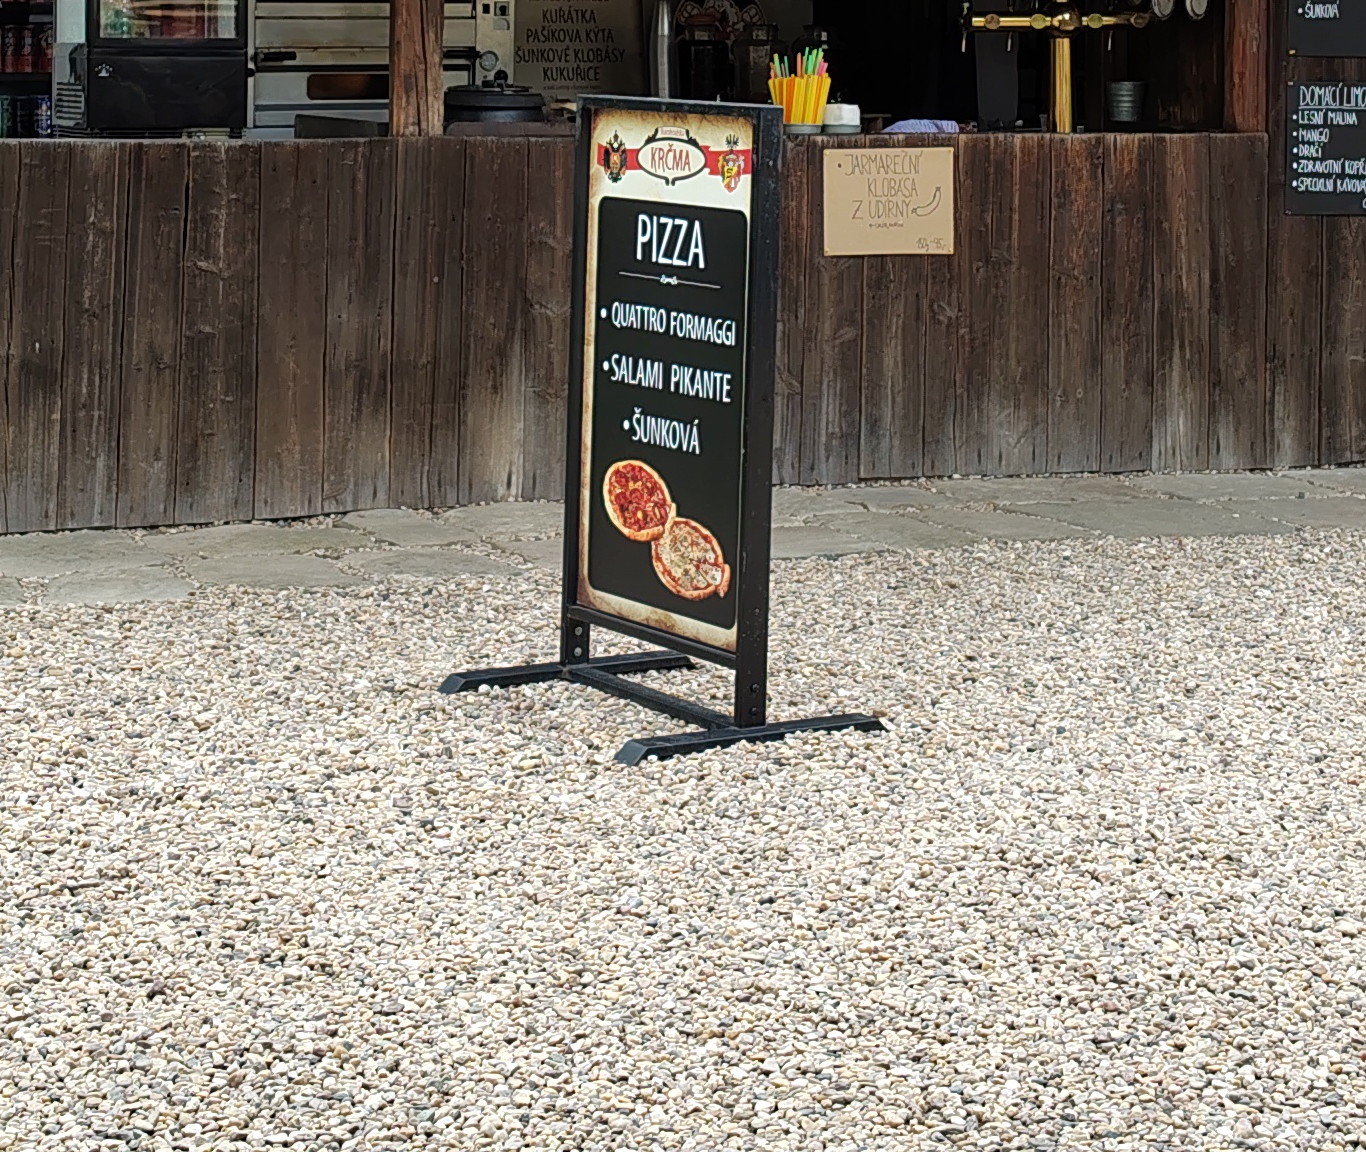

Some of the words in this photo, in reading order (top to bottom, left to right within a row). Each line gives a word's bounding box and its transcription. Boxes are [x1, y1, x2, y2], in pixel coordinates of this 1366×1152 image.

[541, 6, 597, 25] KUŘÁTKA
[1304, 0, 1340, 18] ŠUNKOVÁ
[526, 25, 582, 44] PAŠÍKOVA
[585, 25, 614, 44] KÝTA
[515, 46, 571, 65] ŠUNKOVÉ
[574, 46, 626, 65] KLOBÁSY
[542, 64, 600, 82] KUKUŘICE
[1299, 82, 1343, 106] DOMÁCÍ
[1298, 109, 1326, 125] LESNÍ
[1327, 111, 1358, 125] MALINA
[1298, 128, 1330, 142] MANGO
[650, 142, 692, 173] KRČMA
[844, 150, 923, 176] JARMAREČNÍ
[867, 177, 919, 198] KLOBÁSA
[851, 199, 864, 220] Z
[868, 197, 912, 220] UDÍRNY
[636, 213, 705, 269] PIZZA
[611, 301, 667, 333] QUATTRO
[670, 311, 736, 347] FORMAGGI
[610, 353, 663, 390] SALAMI
[670, 364, 732, 403] PIKANTE
[631, 406, 701, 455] ŠUNKOVÁ
